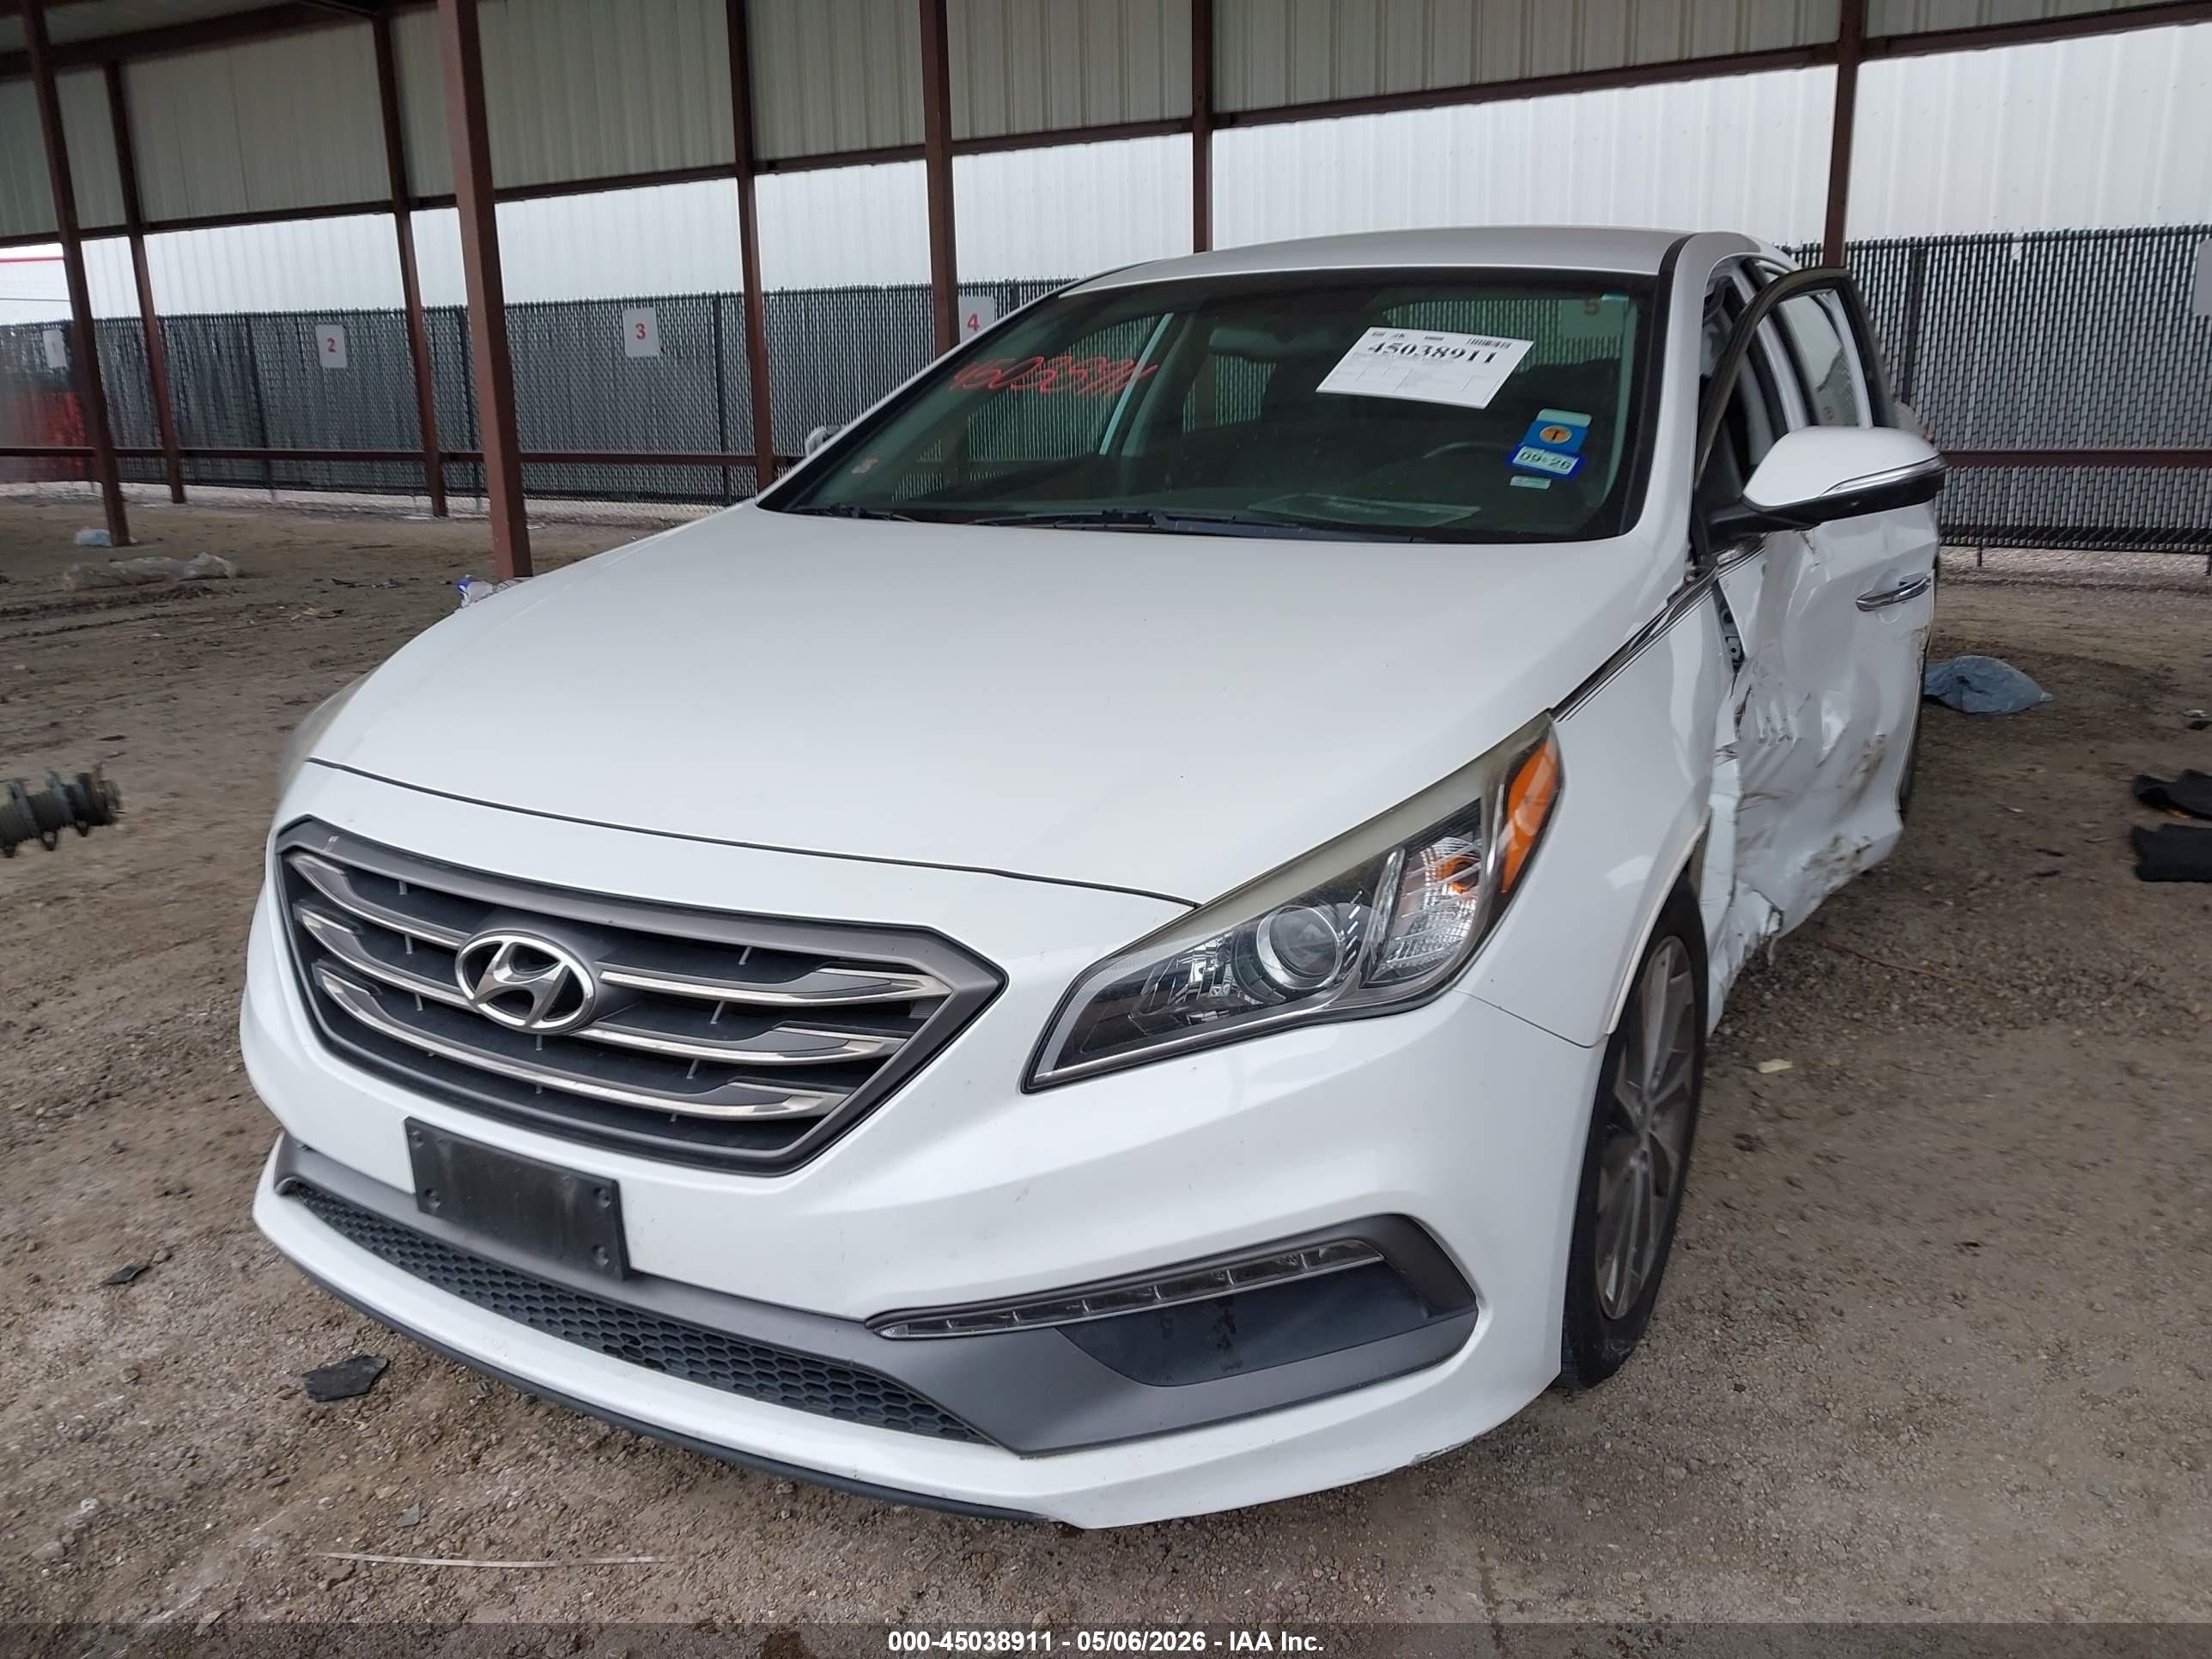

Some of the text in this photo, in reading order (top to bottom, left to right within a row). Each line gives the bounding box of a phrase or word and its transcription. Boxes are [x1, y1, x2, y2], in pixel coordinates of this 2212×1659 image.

[635, 322, 646, 340] 3
[967, 313, 980, 331] 4
[327, 337, 337, 353] 2
[1367, 341, 1498, 365] 45038911
